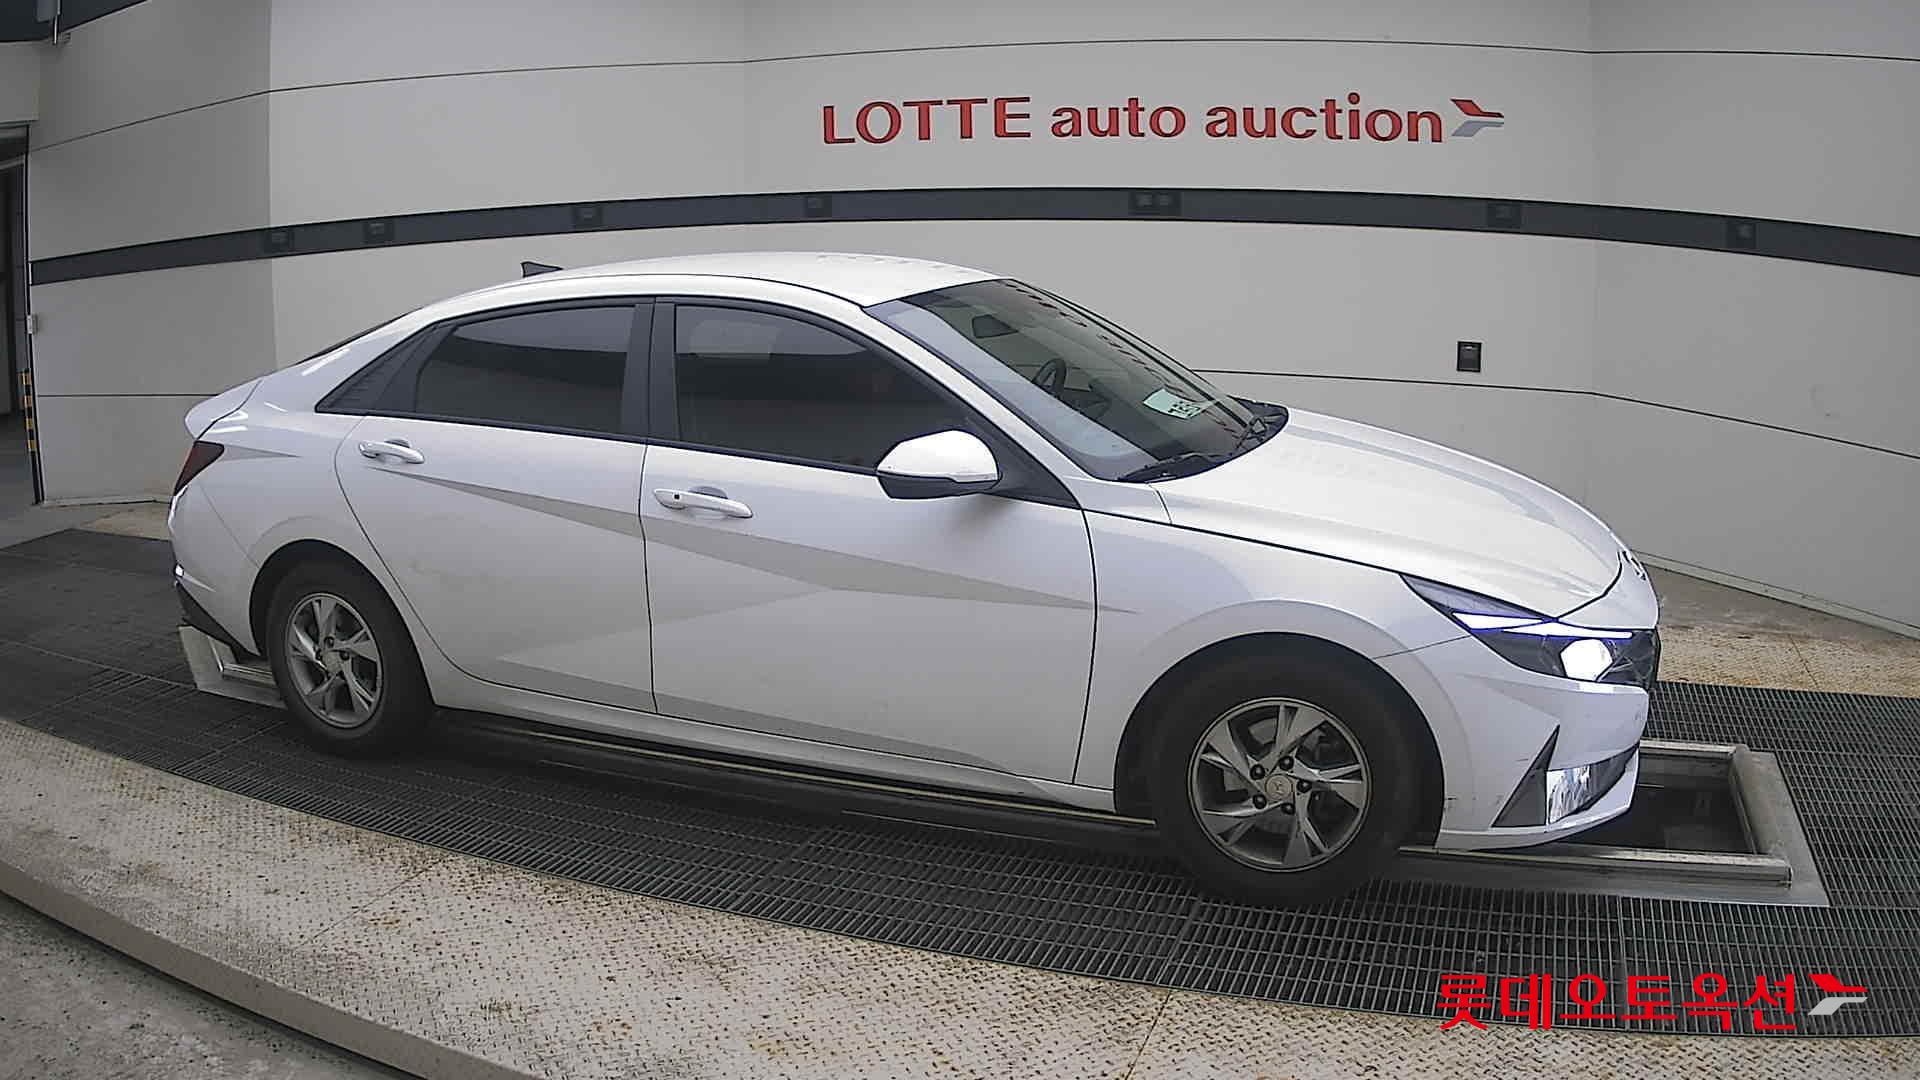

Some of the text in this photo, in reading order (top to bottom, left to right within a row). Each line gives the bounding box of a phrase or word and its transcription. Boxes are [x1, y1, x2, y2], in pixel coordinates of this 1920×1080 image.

[823, 93, 1444, 144] LOTTE auto auction
